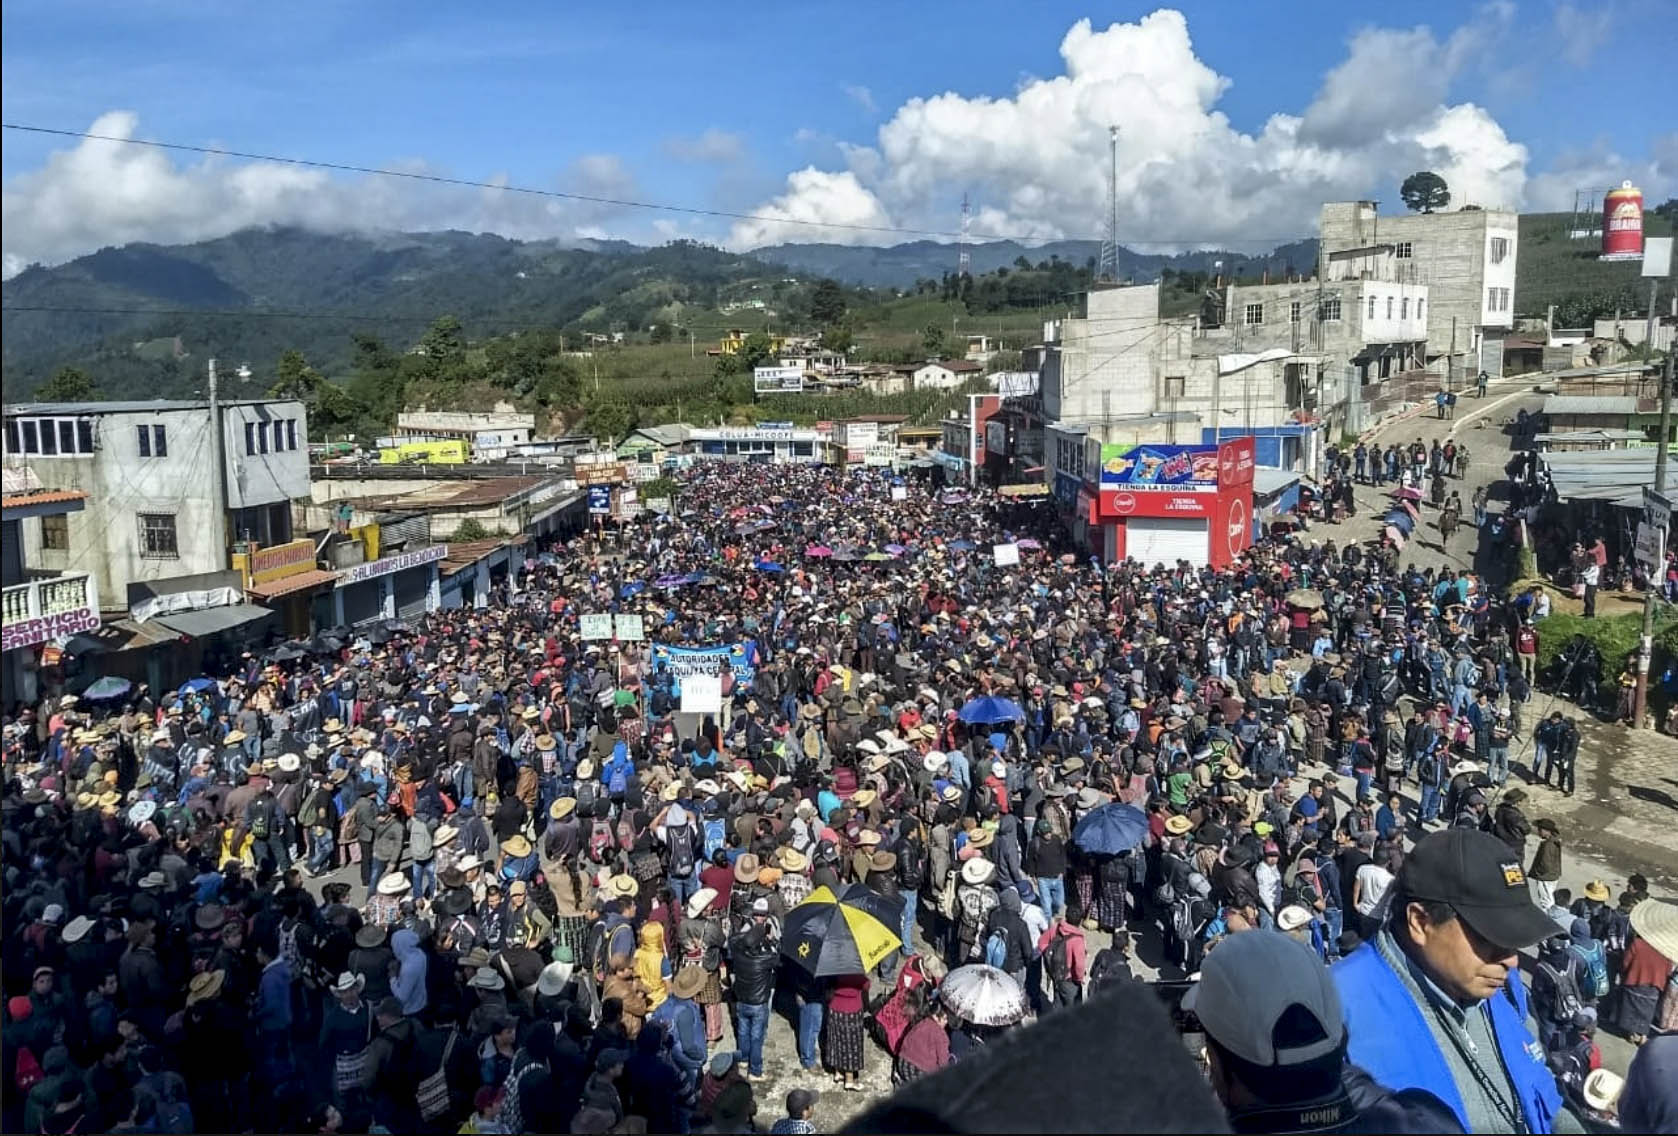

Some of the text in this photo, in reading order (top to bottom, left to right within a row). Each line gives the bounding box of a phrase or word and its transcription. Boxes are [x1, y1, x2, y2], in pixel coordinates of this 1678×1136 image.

[2, 607, 91, 638] SERVICIO
[2, 617, 99, 650] SANITARIO
[1300, 1104, 1341, 1125] Nikon
